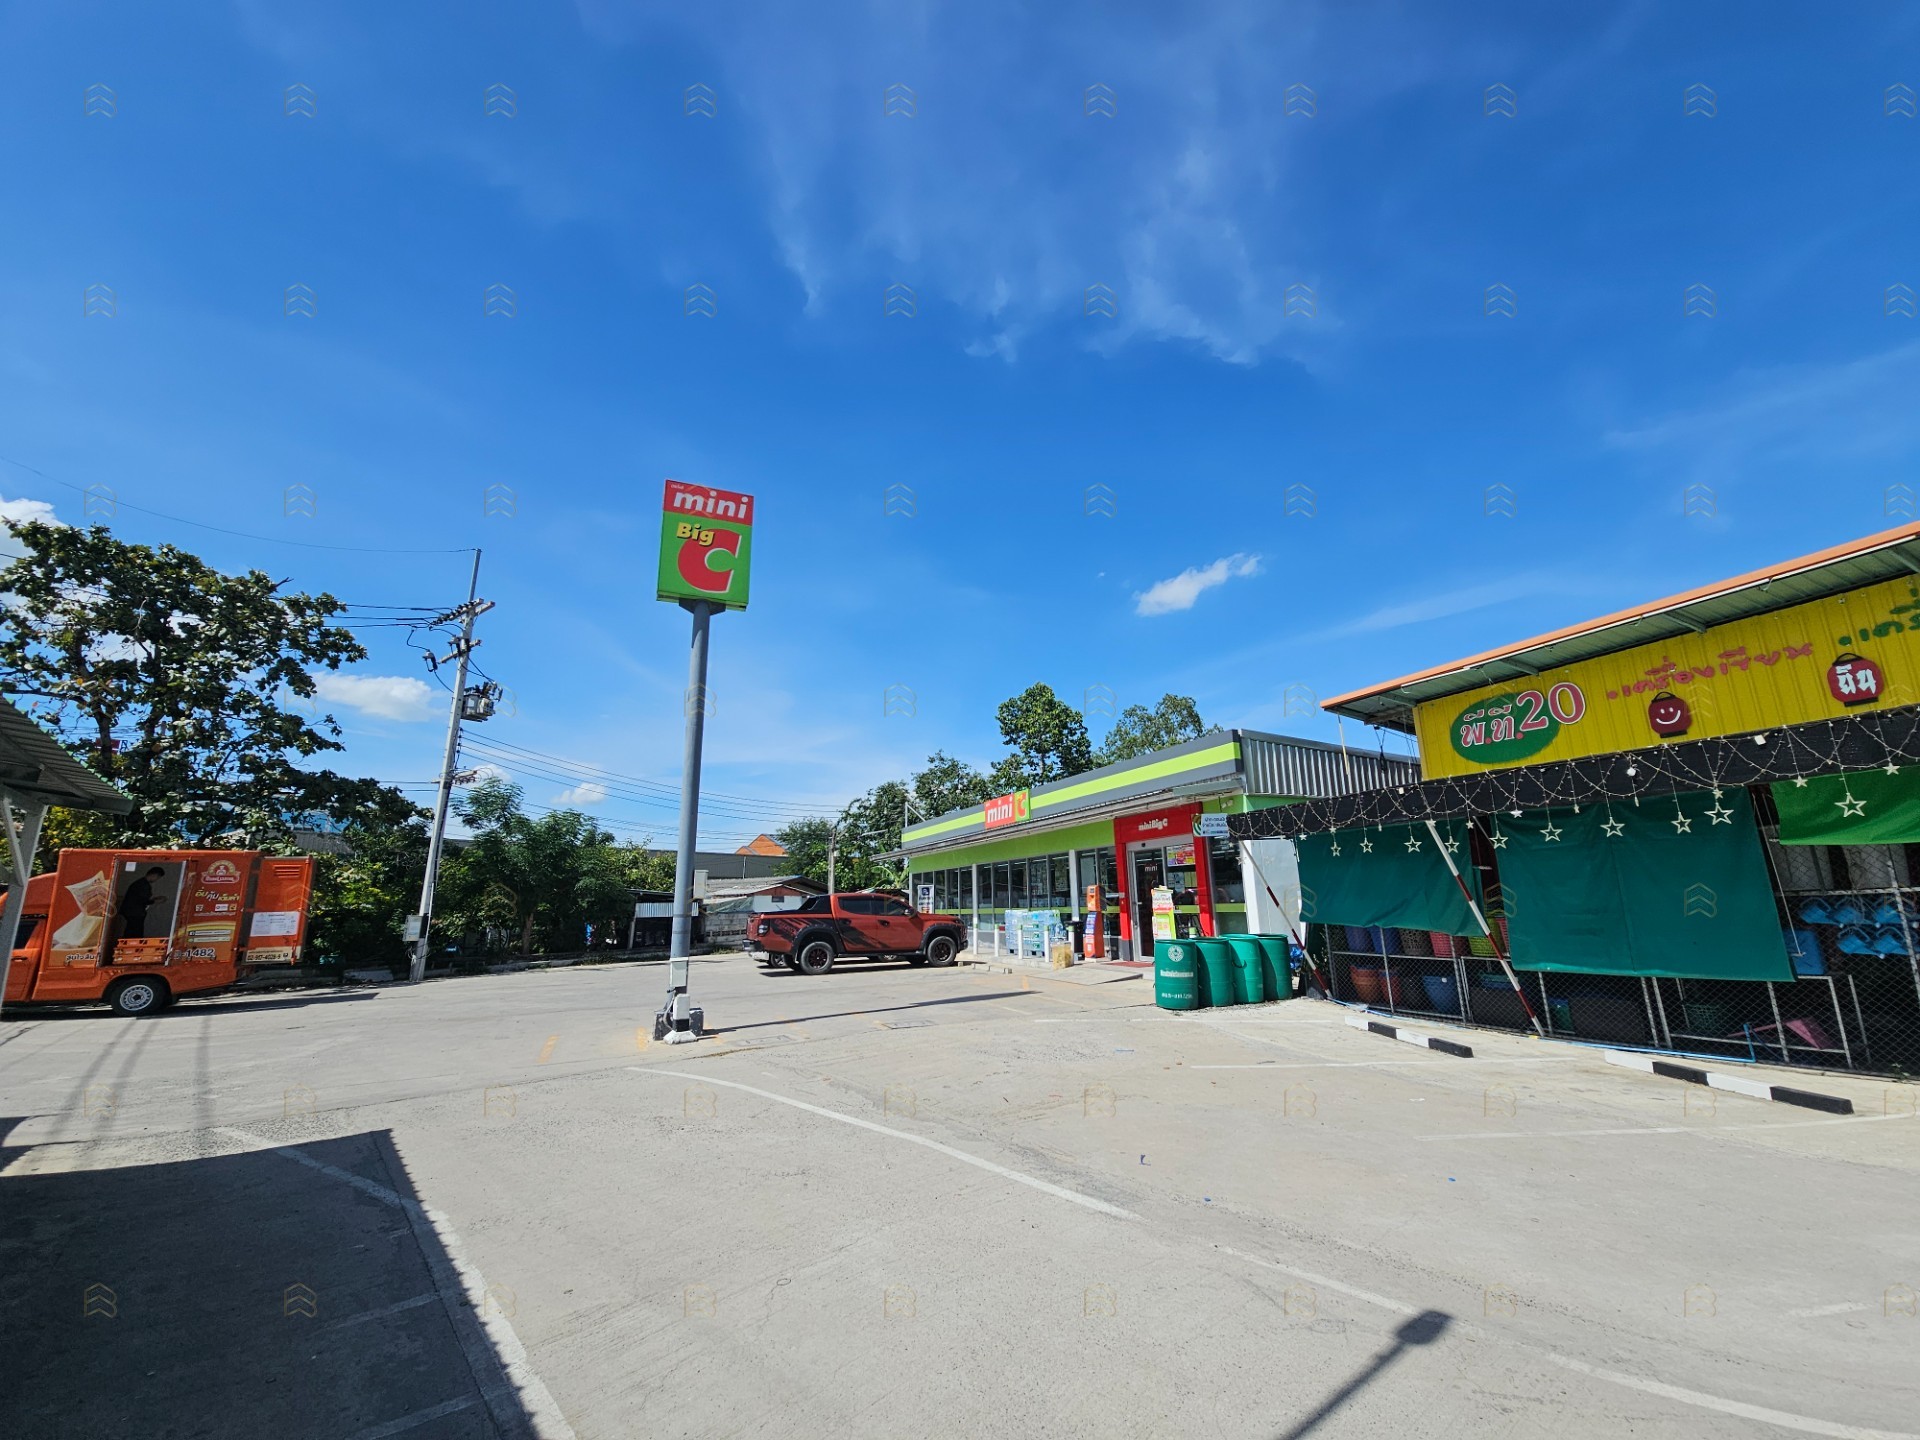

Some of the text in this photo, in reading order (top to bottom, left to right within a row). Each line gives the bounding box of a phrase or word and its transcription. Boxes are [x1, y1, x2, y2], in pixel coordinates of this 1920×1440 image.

[673, 490, 748, 518] mini
[677, 522, 716, 546] Big
[677, 528, 741, 593] C
[987, 796, 1013, 823] mini
